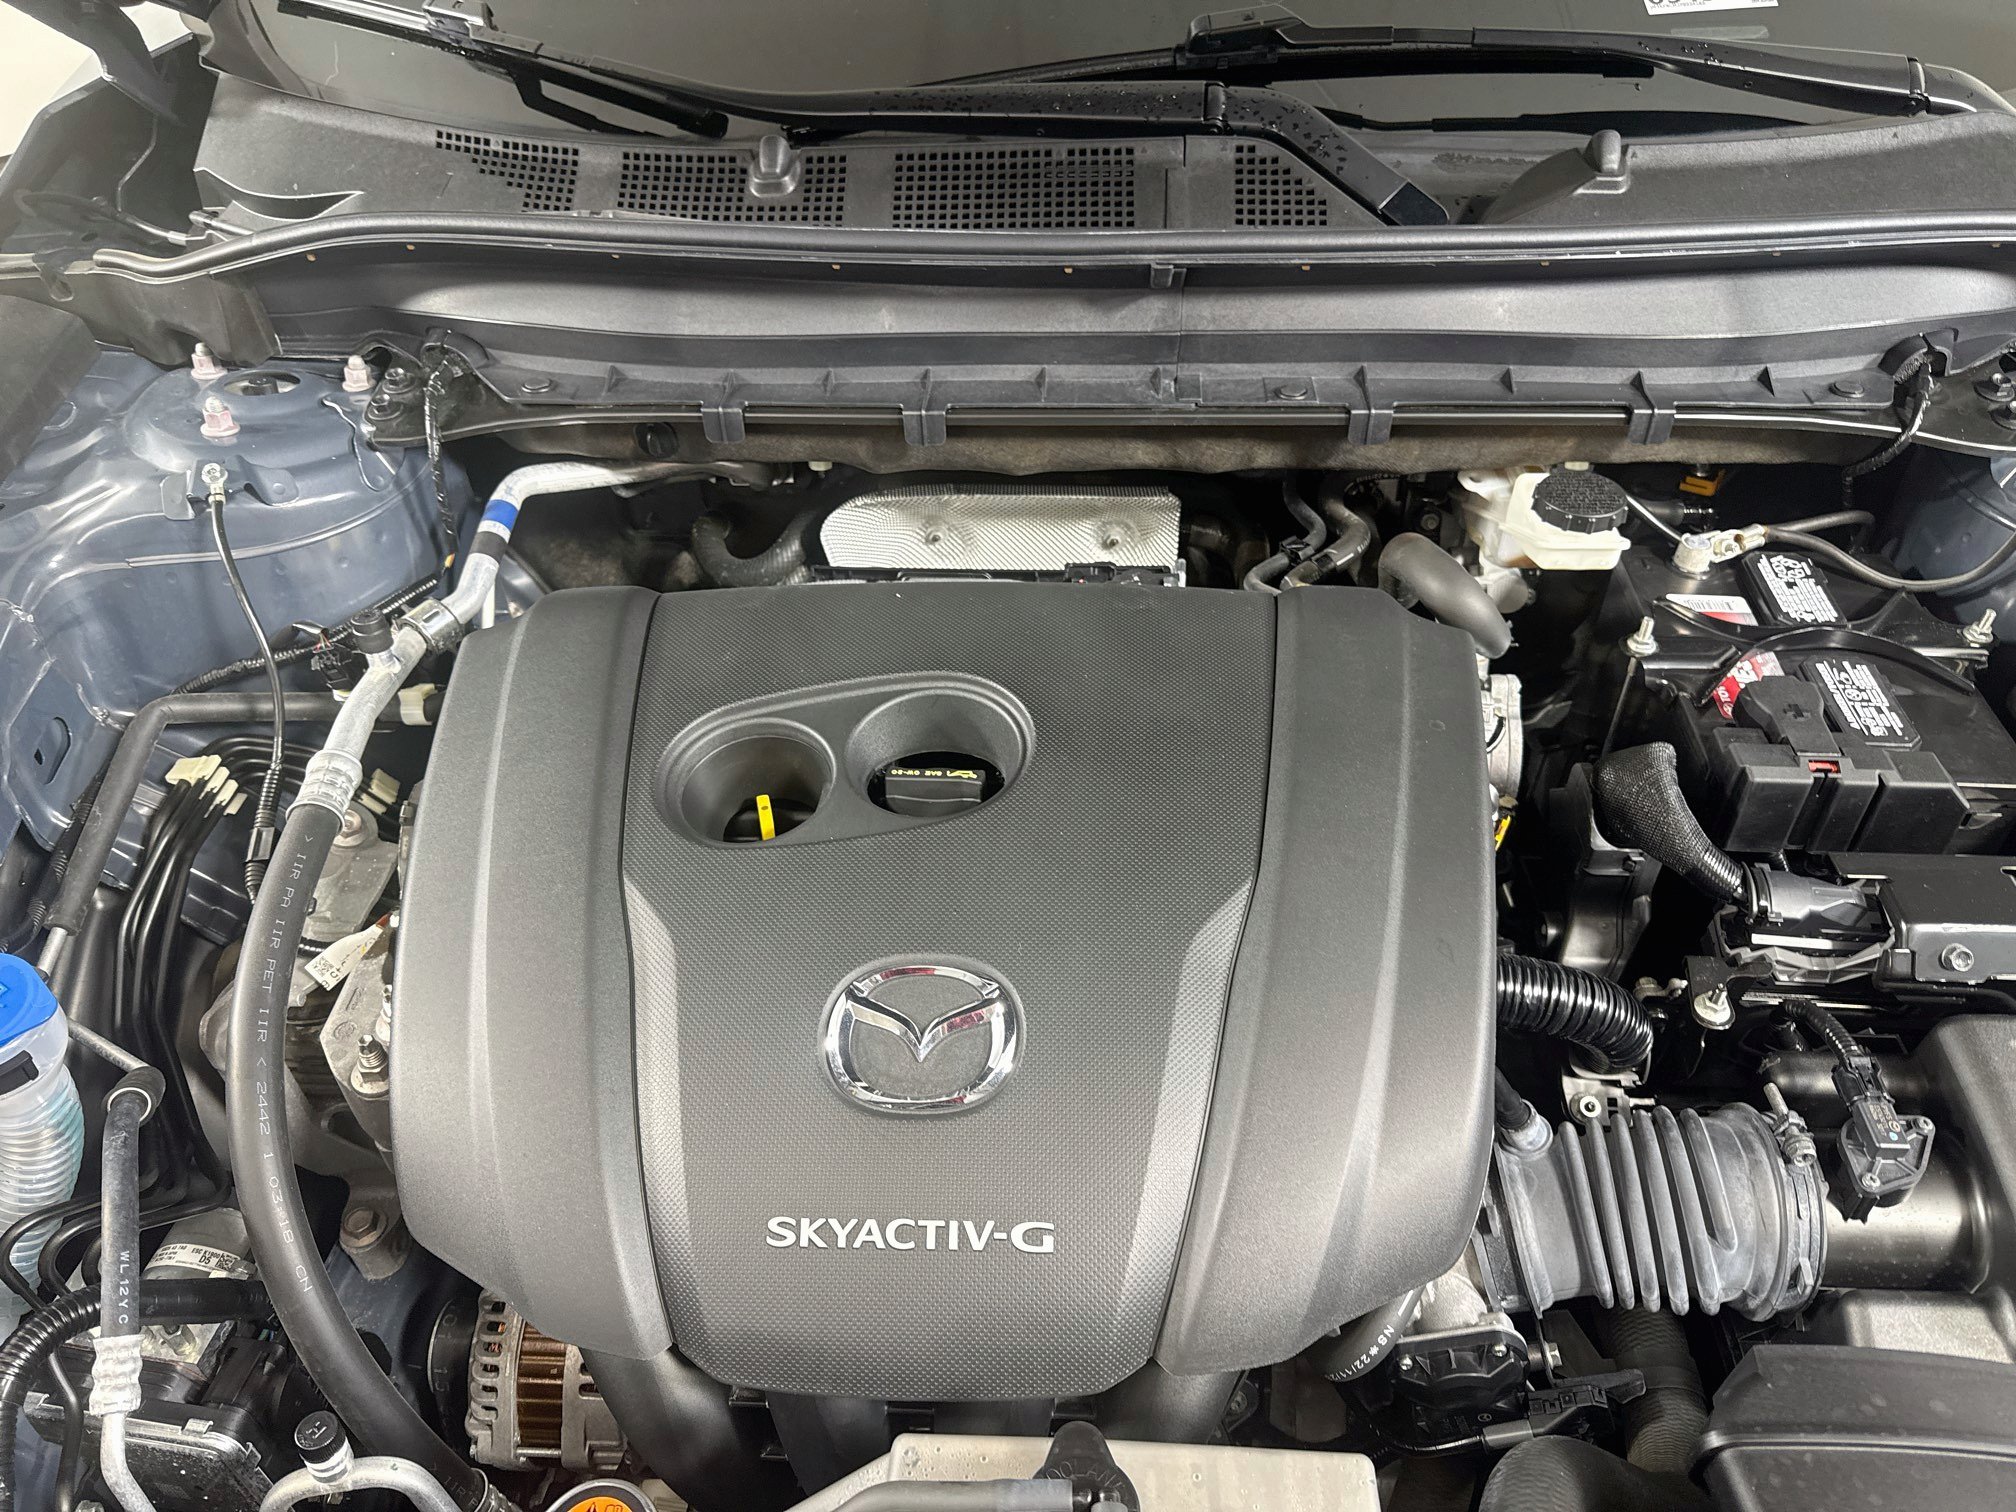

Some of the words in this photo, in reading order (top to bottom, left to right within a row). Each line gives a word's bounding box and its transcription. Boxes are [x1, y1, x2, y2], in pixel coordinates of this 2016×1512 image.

[280, 886, 295, 908] PA
[261, 958, 277, 994] PET
[255, 1083, 271, 1136] 2442
[766, 1216, 1055, 1253] SKYACTIV-G
[295, 1264, 314, 1293] CN
